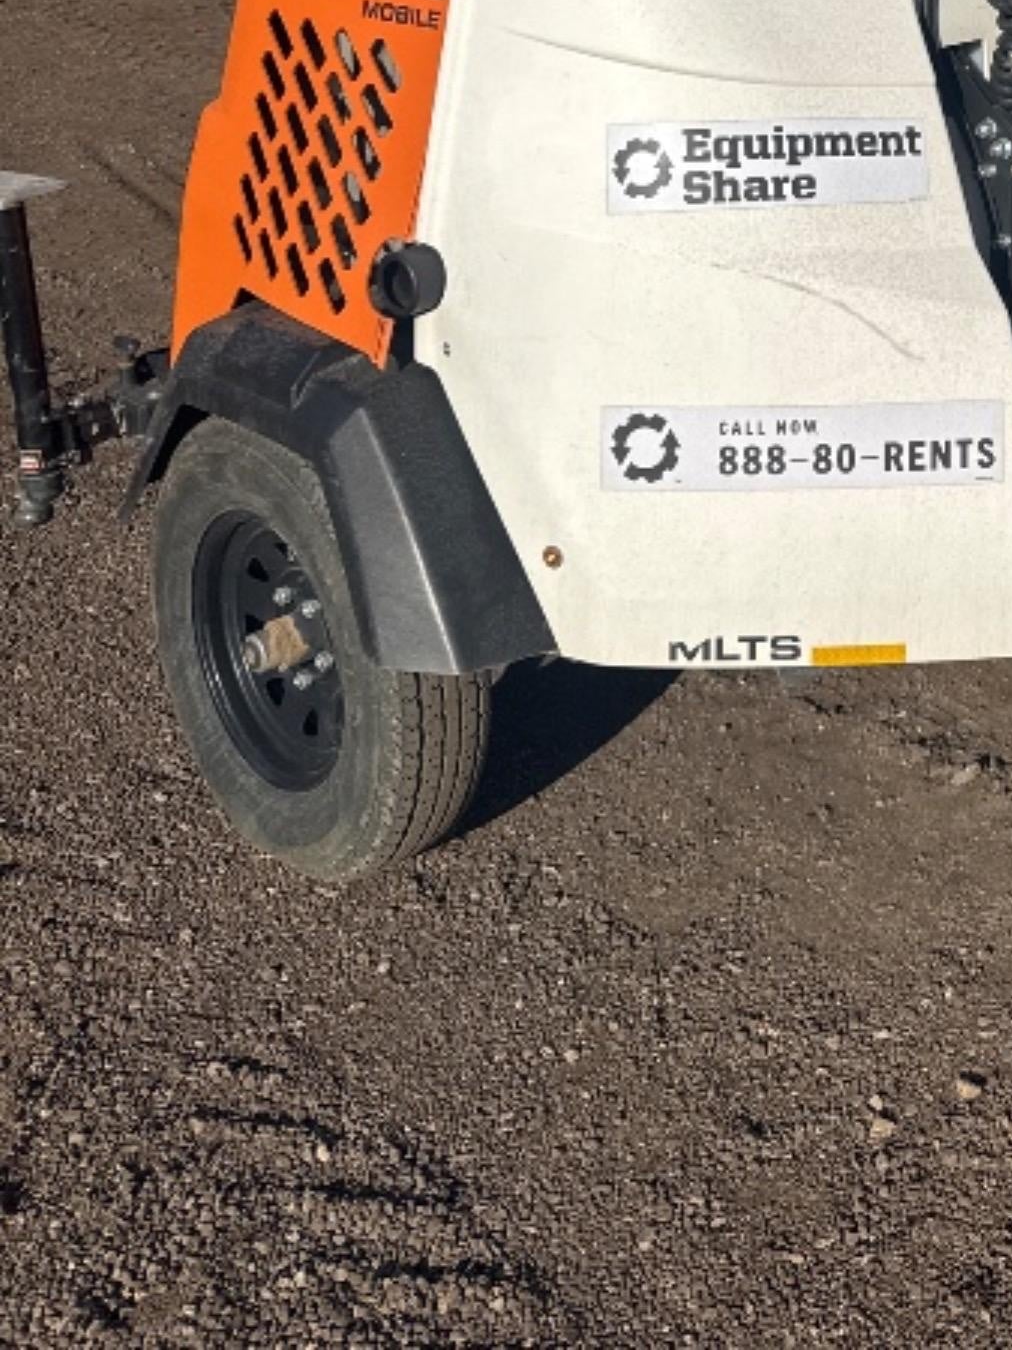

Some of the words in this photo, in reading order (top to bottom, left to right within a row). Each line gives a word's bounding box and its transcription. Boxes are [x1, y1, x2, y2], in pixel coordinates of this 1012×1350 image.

[362, 0, 441, 30] MOBILE
[682, 126, 921, 168] Equipment
[682, 170, 817, 204] Share
[719, 420, 765, 436] CALL
[719, 438, 996, 475] 888-80-RENTS
[669, 635, 802, 662] MLTS
